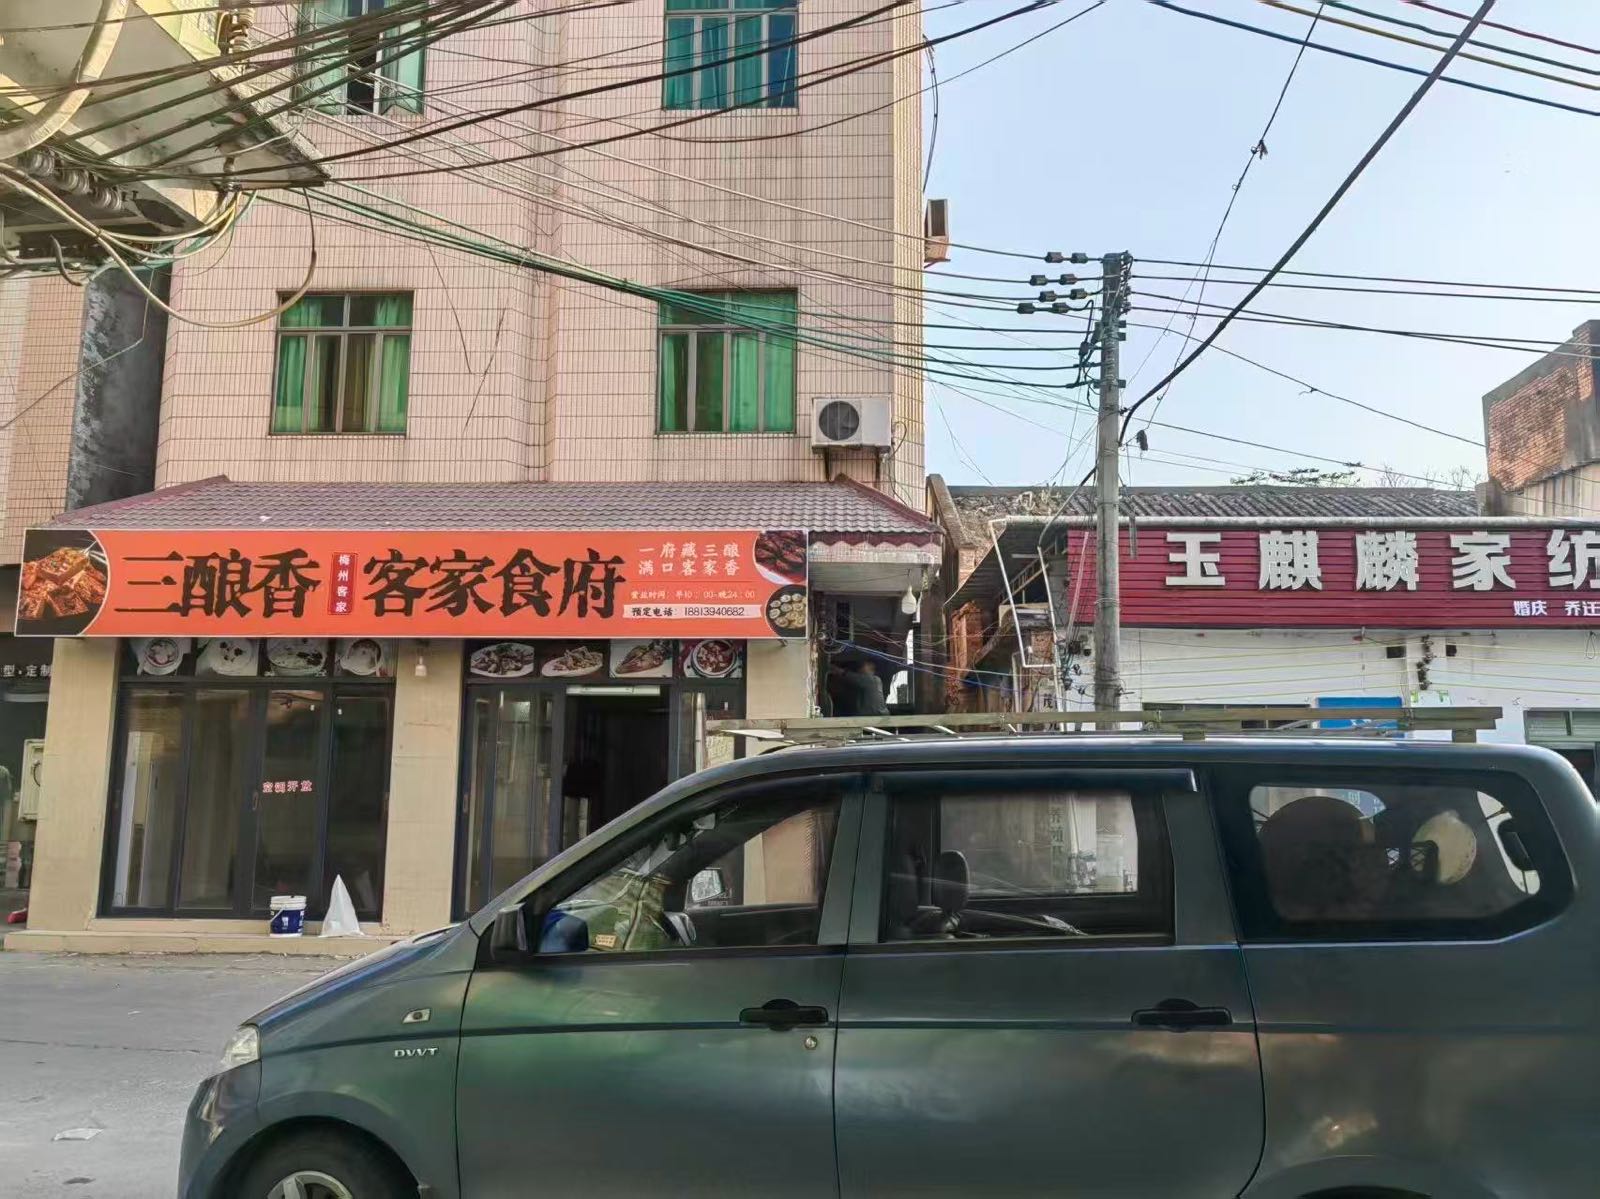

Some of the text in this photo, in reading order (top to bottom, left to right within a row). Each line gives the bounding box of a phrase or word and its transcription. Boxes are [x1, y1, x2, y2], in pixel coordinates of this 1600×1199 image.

[638, 559, 740, 576] 满口客家香
[1165, 529, 1600, 591] 玉麒麟家纺
[114, 548, 626, 619] 三酿香 客家食府
[335, 553, 350, 613] 梅州客家
[1513, 600, 1548, 616] 婚庆
[394, 1047, 439, 1057] DVVT
